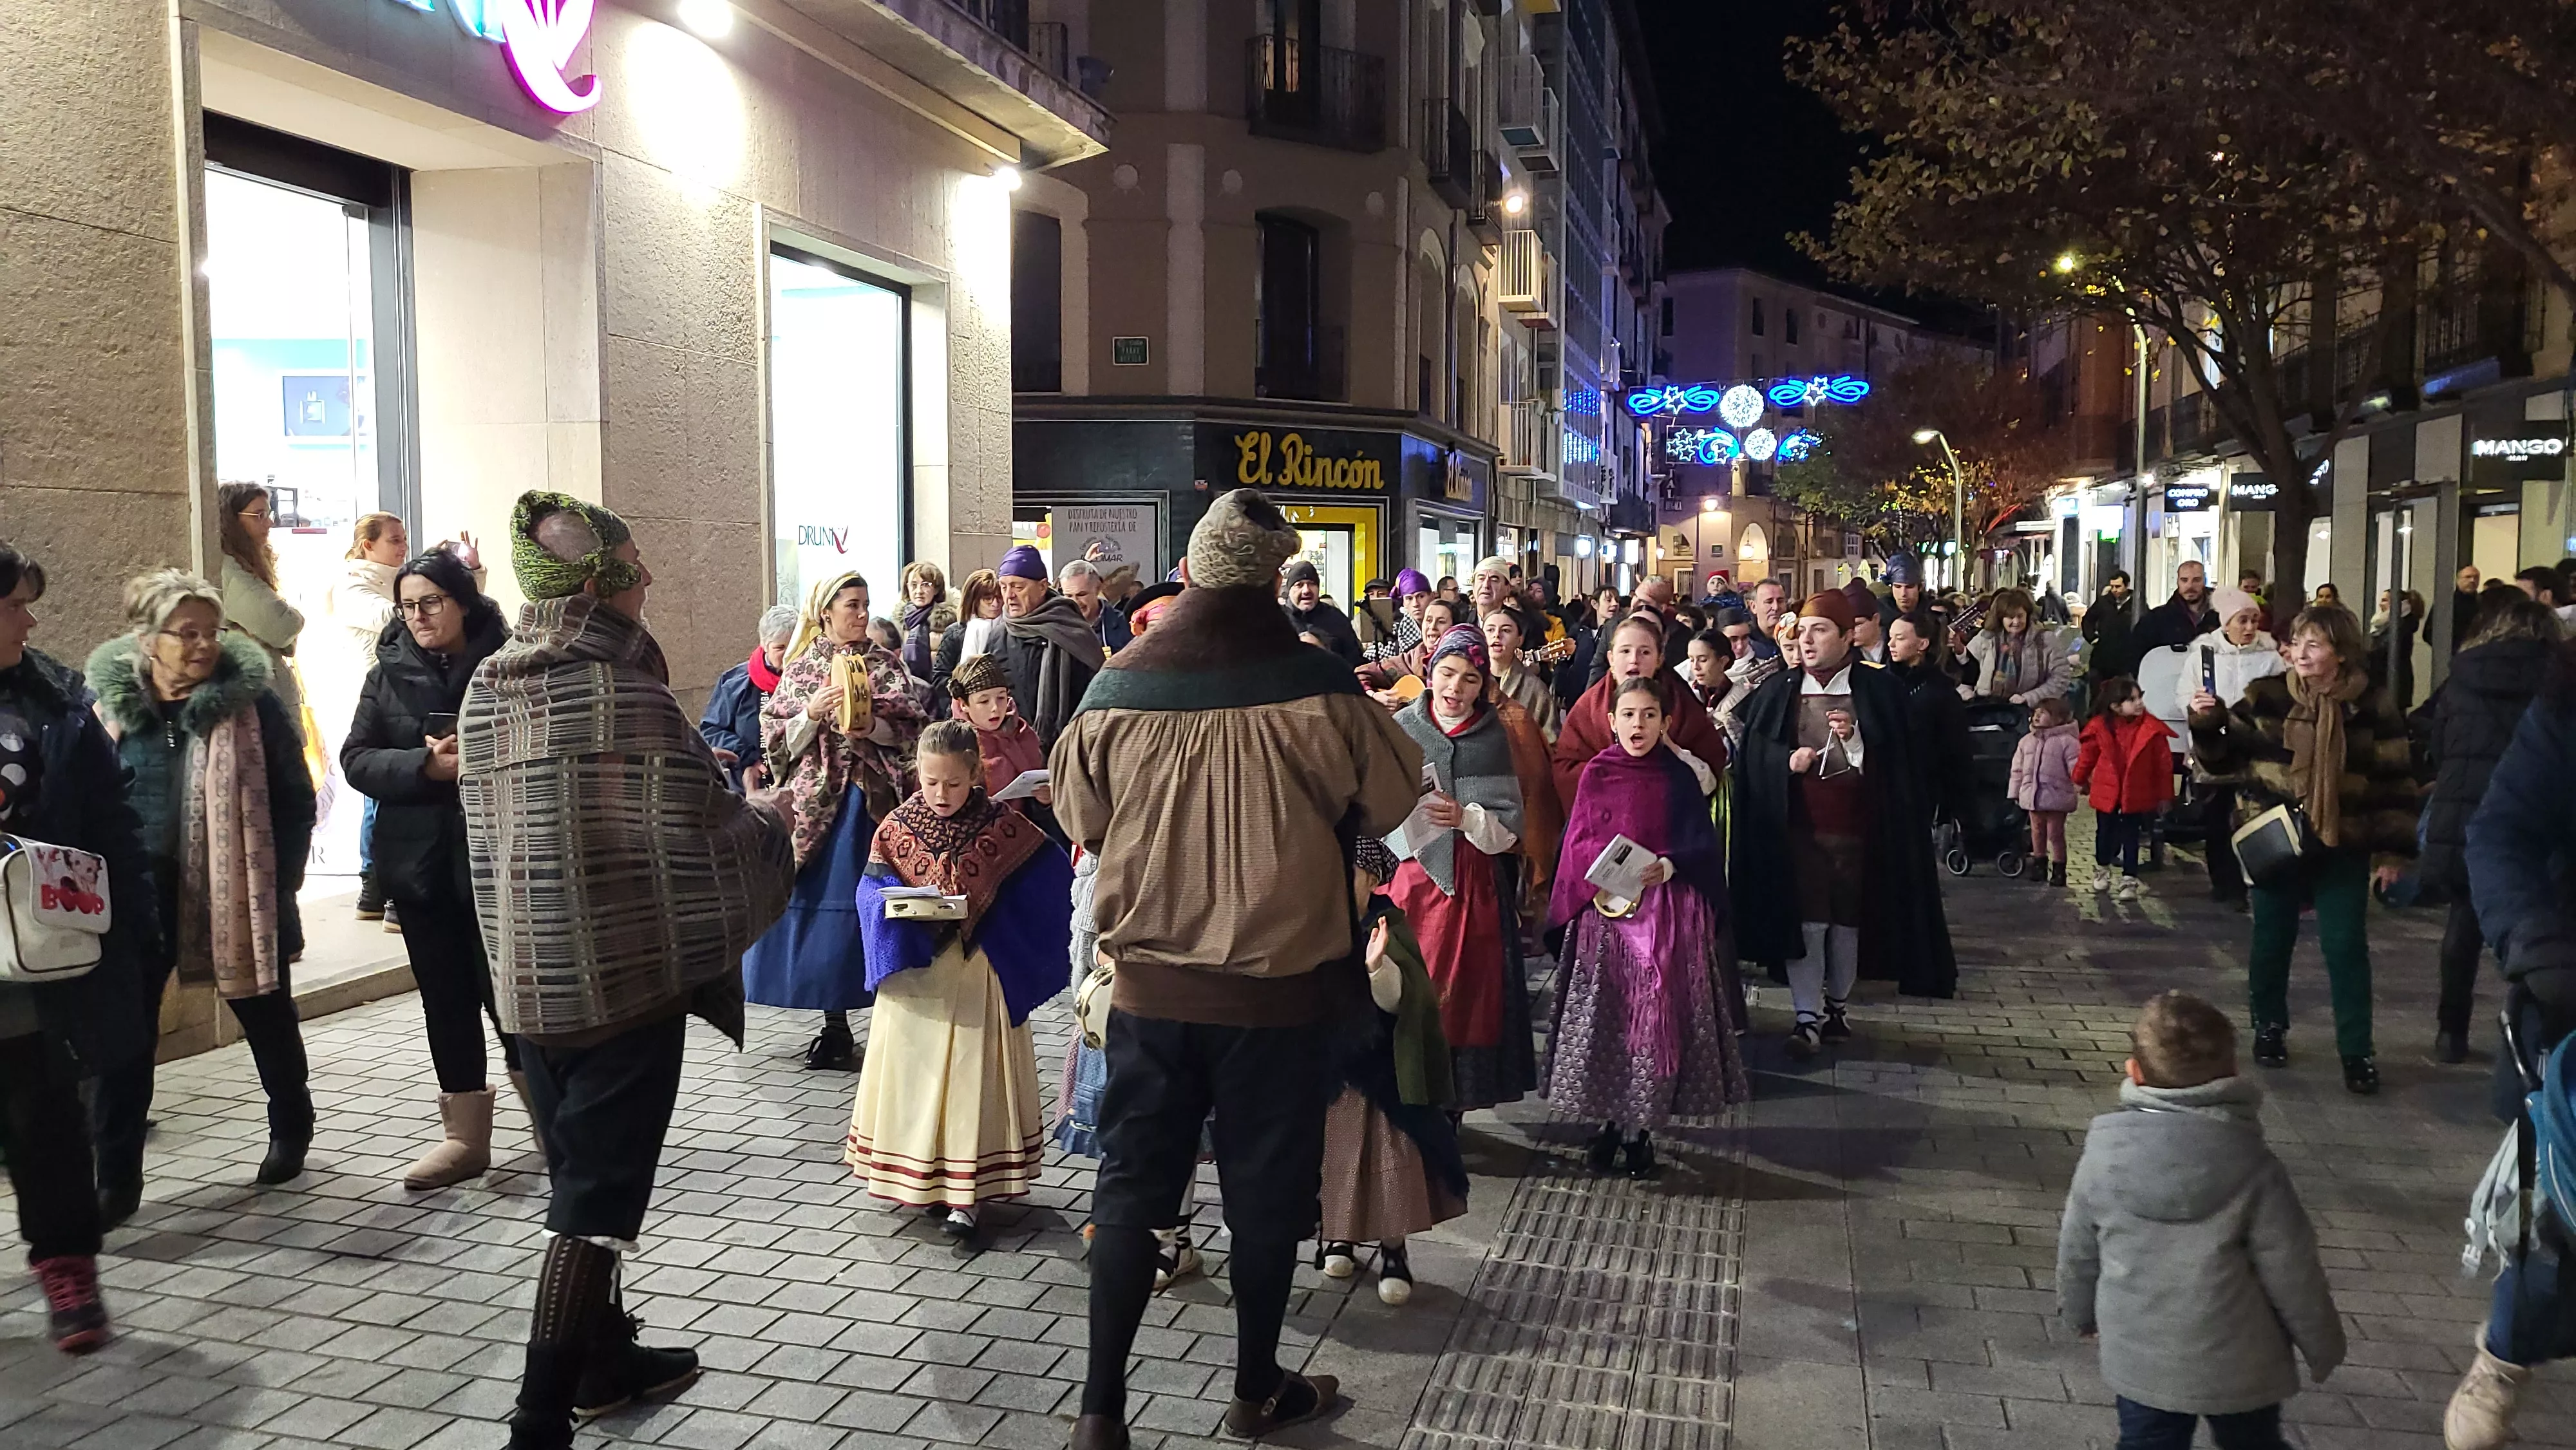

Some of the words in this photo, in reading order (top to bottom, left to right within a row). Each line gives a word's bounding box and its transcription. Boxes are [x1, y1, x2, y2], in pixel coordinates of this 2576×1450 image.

[2474, 438, 2562, 455] MANGO
[1235, 431, 1273, 485] El
[1278, 432, 1385, 490] Rincón
[2167, 488, 2208, 498] COMPRO
[2231, 484, 2279, 495] MANG
[1068, 509, 1099, 520] DISFRUTA
[1100, 509, 1107, 520] DE
[1109, 508, 1137, 520] NUESTRO
[1069, 522, 1083, 532] PAN
[1084, 522, 1088, 532] Y
[1128, 522, 1137, 532] DE
